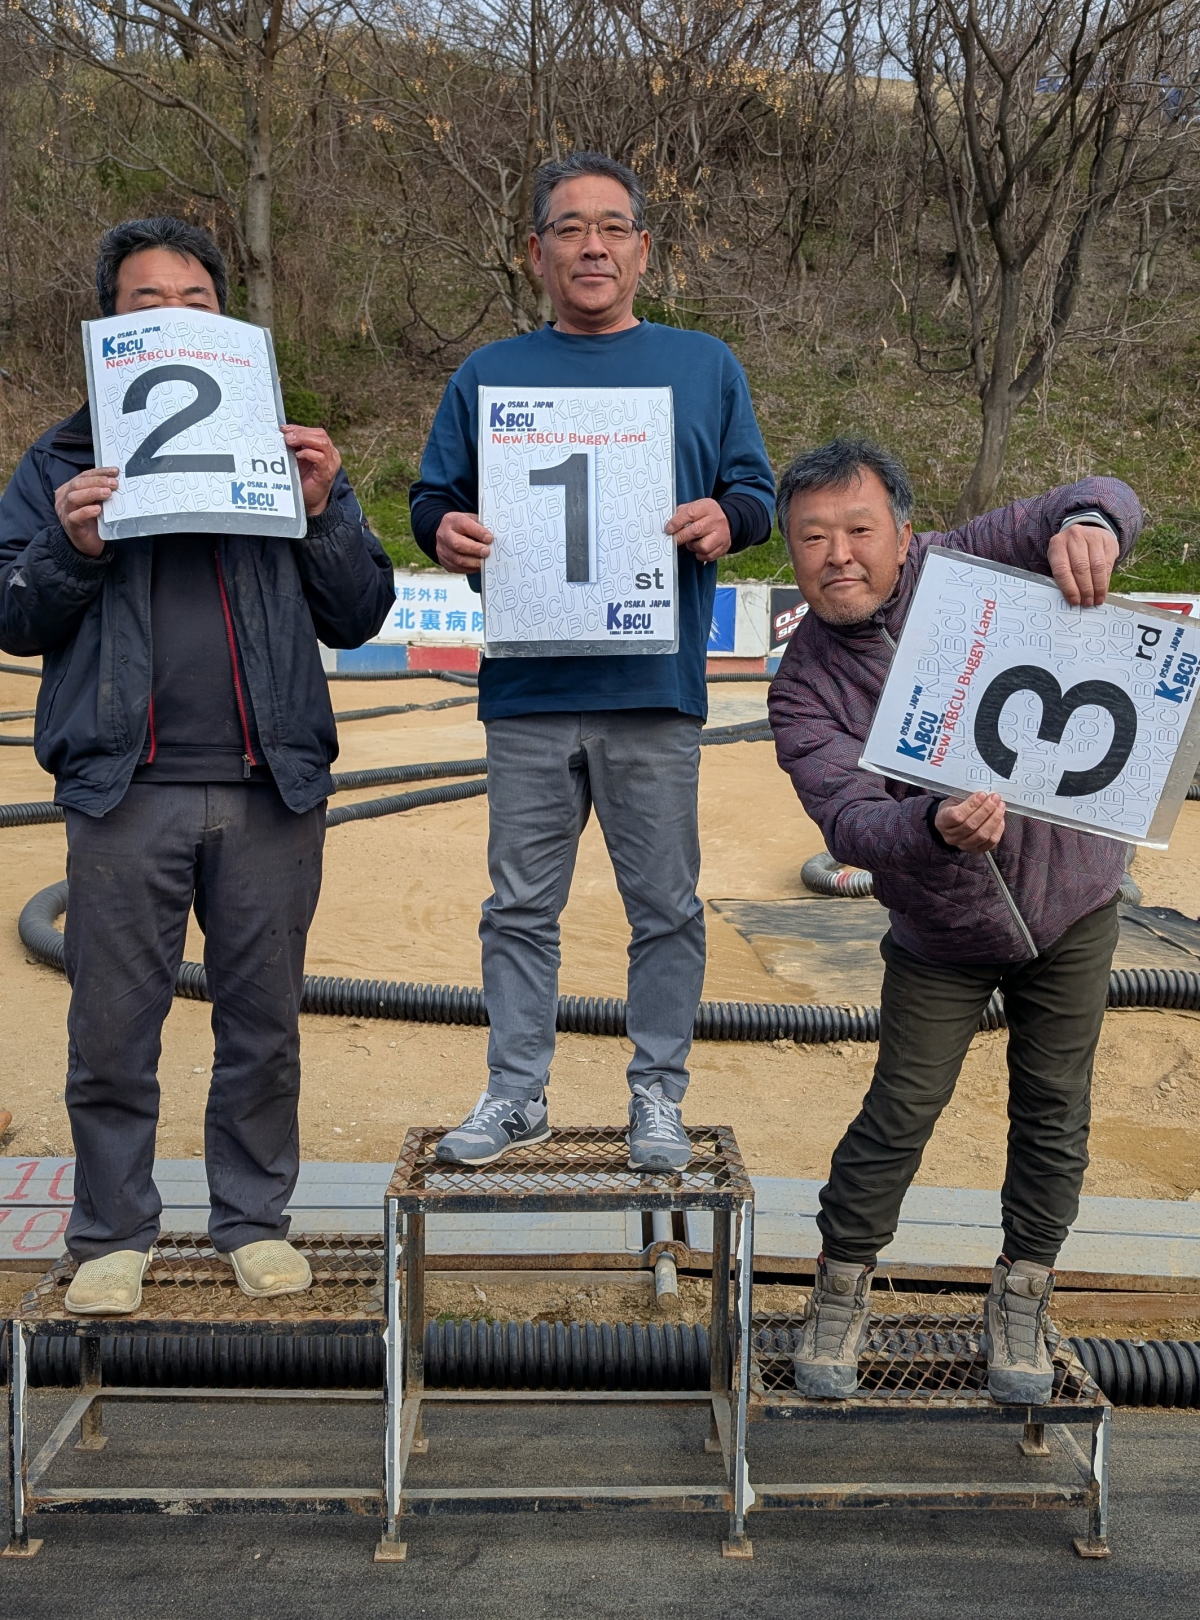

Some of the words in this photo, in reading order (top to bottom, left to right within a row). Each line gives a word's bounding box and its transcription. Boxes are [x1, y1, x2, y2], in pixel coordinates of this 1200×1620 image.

[102, 336, 144, 358] KBCU
[117, 330, 137, 339] OSAKA
[105, 356, 135, 369] New
[137, 349, 174, 362] KBCU
[178, 349, 219, 361] Buggy
[222, 352, 251, 367] Land
[122, 364, 236, 478] 2
[489, 402, 535, 427] KBCU
[491, 433, 522, 444] New
[527, 432, 564, 444] KBCU
[568, 432, 610, 446] Buggy
[613, 431, 647, 443] Land
[251, 456, 287, 475] nd
[231, 481, 275, 507] KBCU
[529, 453, 590, 583] 1
[635, 568, 665, 590] st
[607, 602, 652, 630] KBCU
[624, 600, 646, 608] OSAKA
[1135, 623, 1163, 661] rd
[1159, 654, 1175, 679] OSAKA
[1169, 627, 1185, 652] JAPAN
[929, 733, 951, 768] New
[942, 689, 966, 732] KBCU
[957, 639, 986, 686] Buggy
[974, 599, 996, 637] Land
[1154, 652, 1198, 704] KBCU
[900, 712, 915, 736] OSAKA
[908, 685, 923, 710] JAPAN
[896, 710, 939, 762] KBCU
[974, 664, 1137, 797] 3
